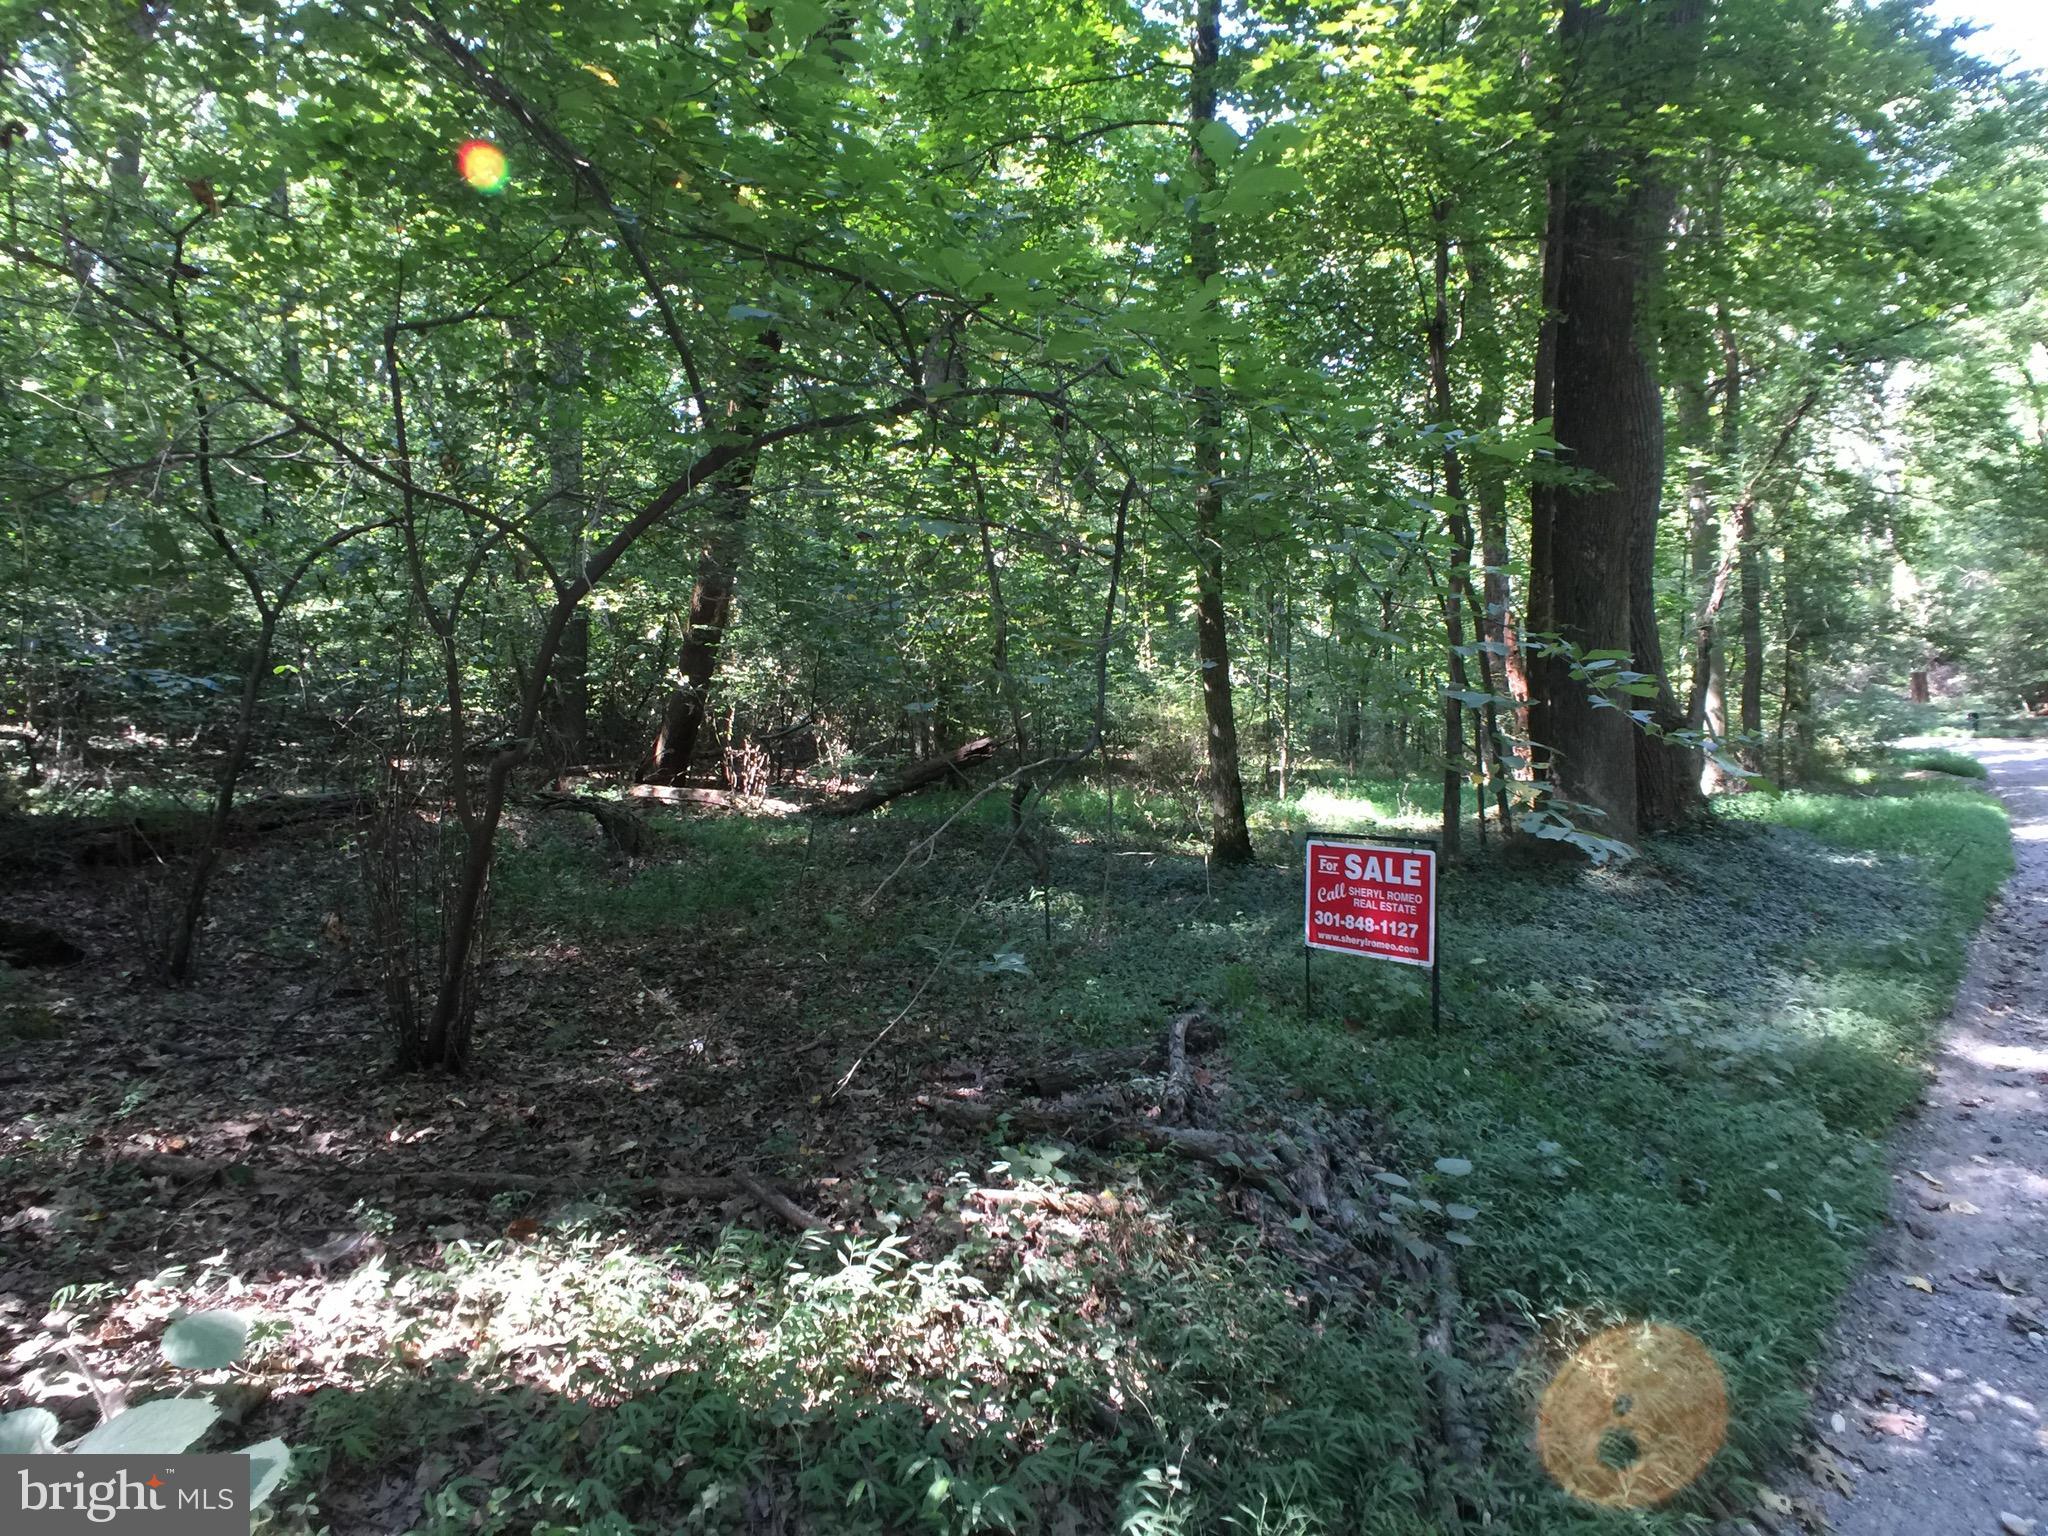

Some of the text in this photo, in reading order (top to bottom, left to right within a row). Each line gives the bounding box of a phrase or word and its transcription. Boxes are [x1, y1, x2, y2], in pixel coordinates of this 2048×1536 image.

[1319, 853, 1422, 887] For SALE
[1317, 882, 1423, 904] Call SHERYL ROMEO
[1353, 898, 1417, 915] REAL ESTATE
[1314, 910, 1419, 939] 301-848-1127
[1317, 932, 1419, 954] www.sherylromeo.com
